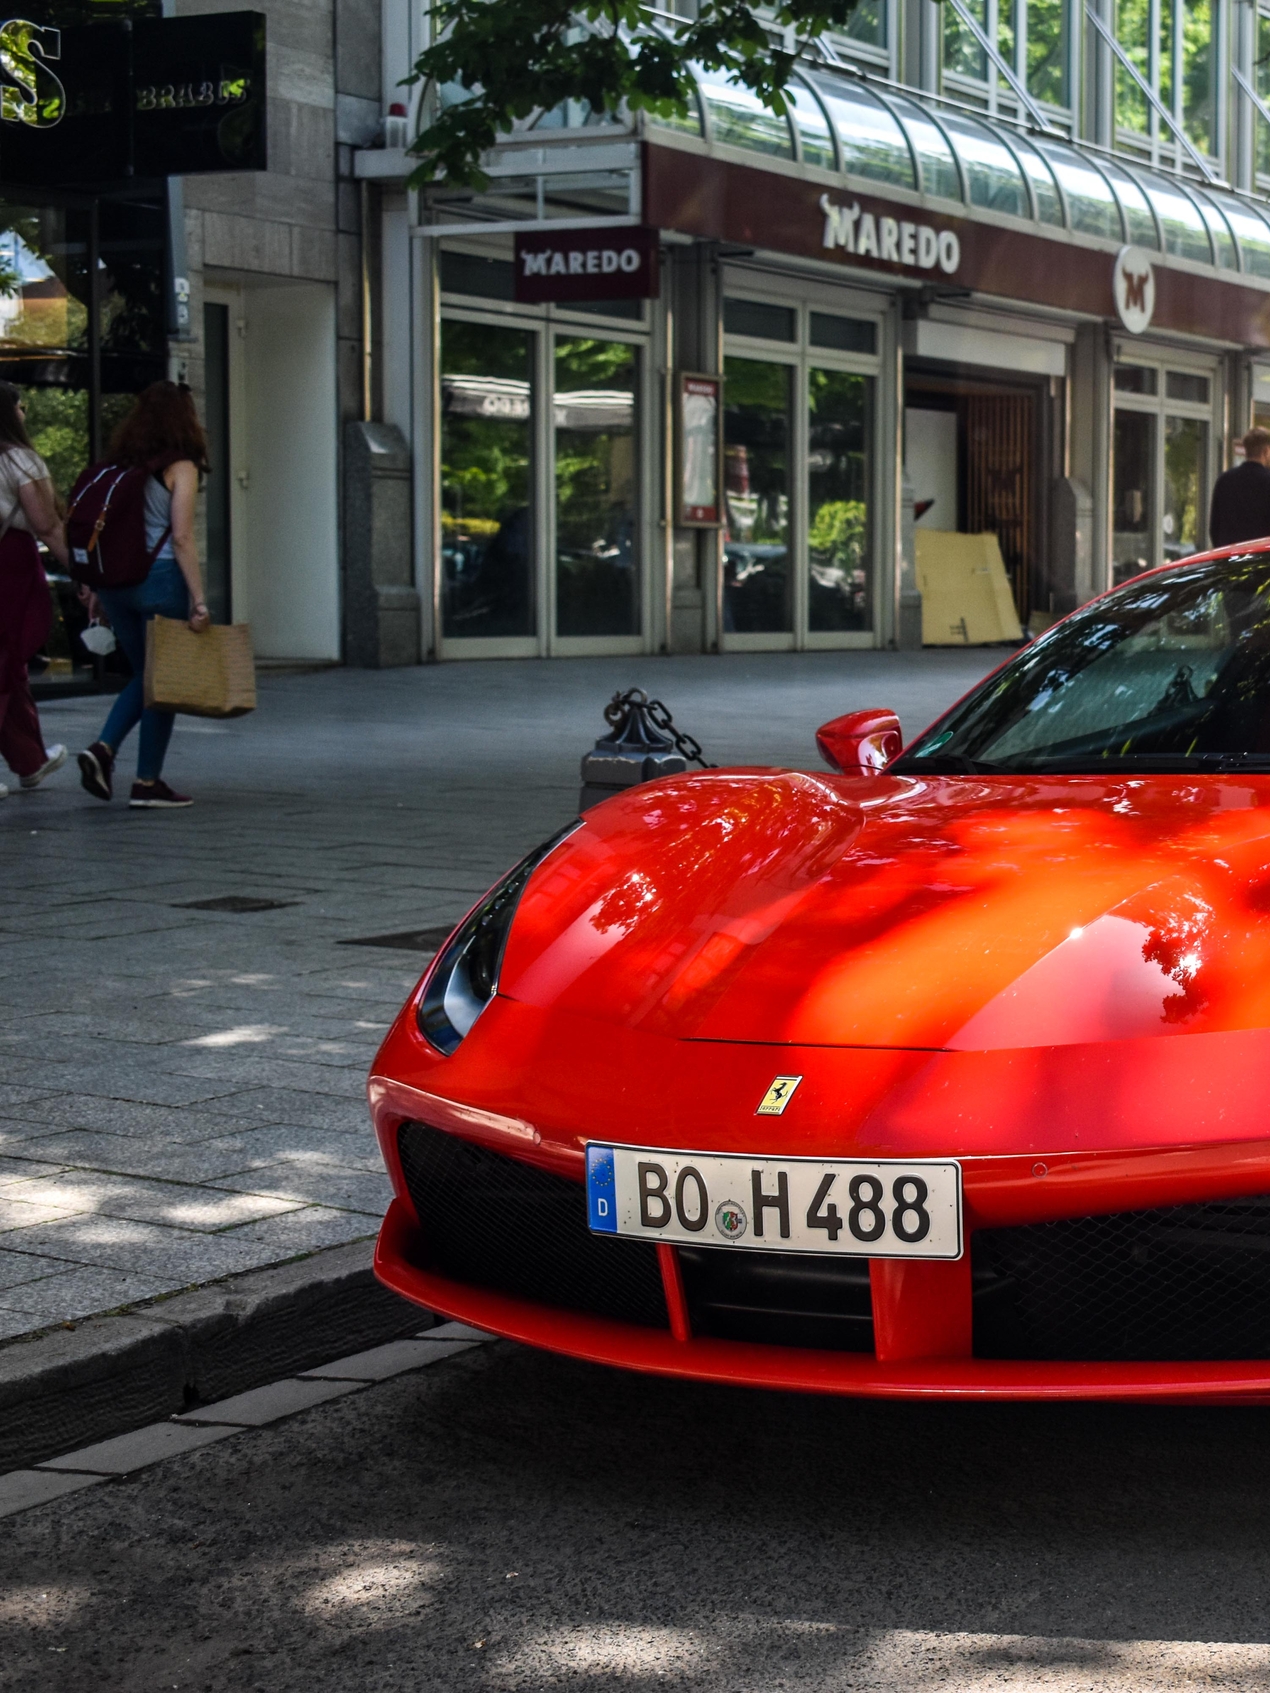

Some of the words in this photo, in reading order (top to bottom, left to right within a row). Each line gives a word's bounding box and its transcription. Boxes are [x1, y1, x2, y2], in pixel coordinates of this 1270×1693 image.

[820, 193, 960, 274] MAREDO
[520, 249, 641, 276] MAREDO
[598, 1198, 608, 1216] D
[637, 1161, 709, 1232] BO
[751, 1169, 791, 1239] H
[806, 1173, 931, 1242] 488
